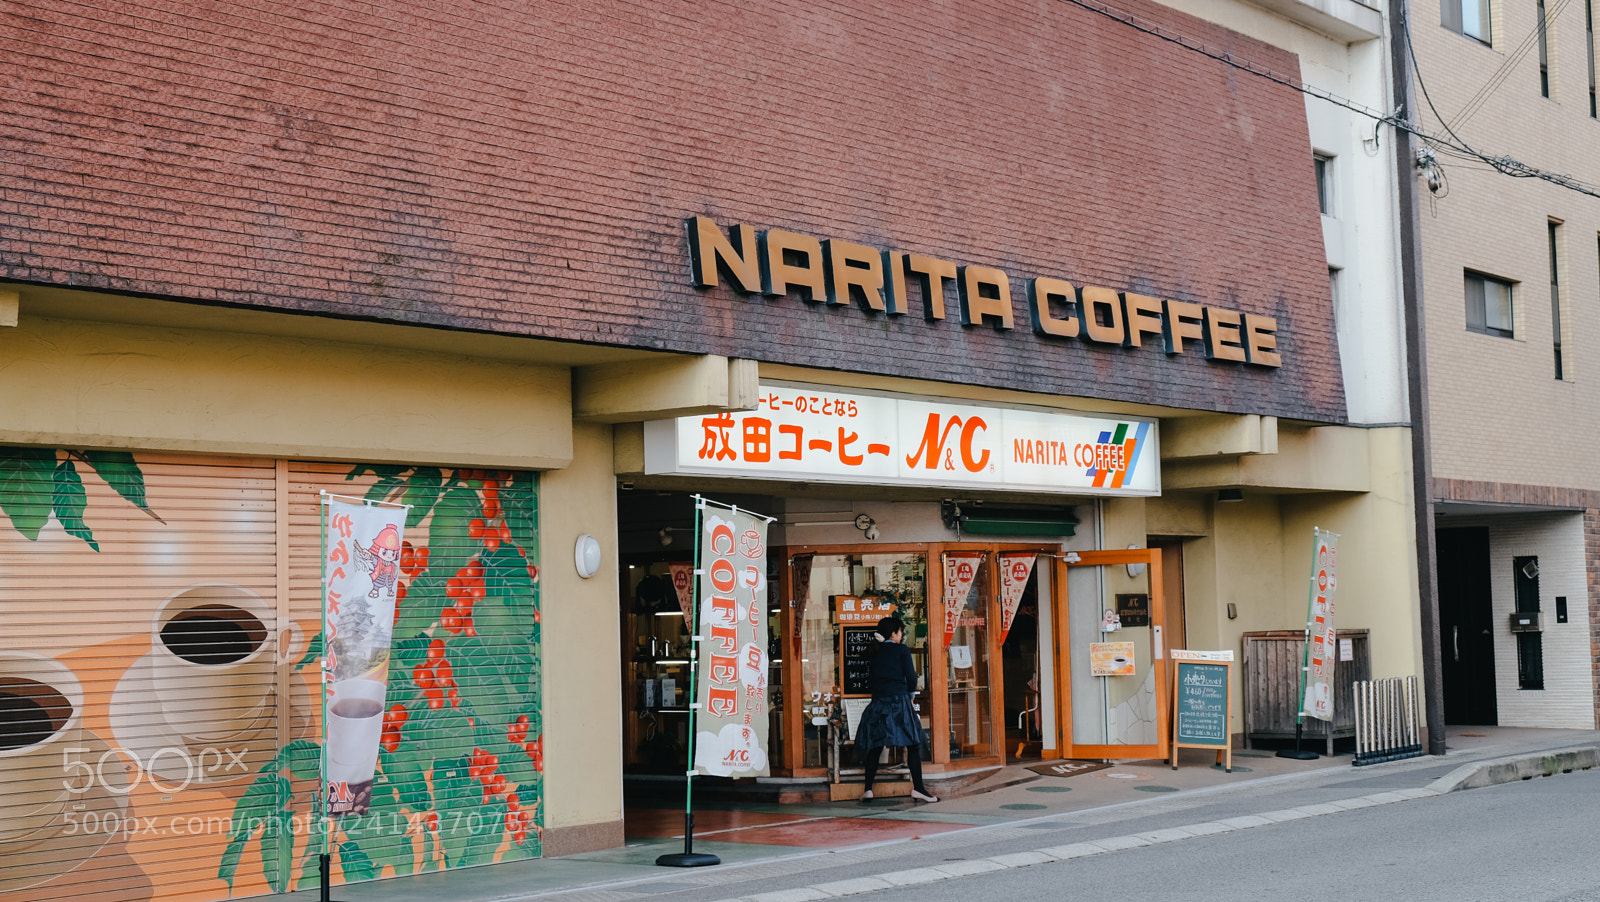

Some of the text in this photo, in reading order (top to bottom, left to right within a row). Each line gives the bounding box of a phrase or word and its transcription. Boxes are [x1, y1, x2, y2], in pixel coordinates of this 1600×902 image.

[689, 216, 1282, 369] NARITA COFFEE
[758, 393, 858, 417] ーヒーのことなら
[699, 413, 890, 466] 成田コーヒー
[906, 412, 991, 473] N&C
[1014, 438, 1125, 471] NARITA COFFEE
[708, 524, 739, 718] COFFEE
[746, 566, 763, 672] コーヒー豆
[1171, 651, 1200, 659] OPEN
